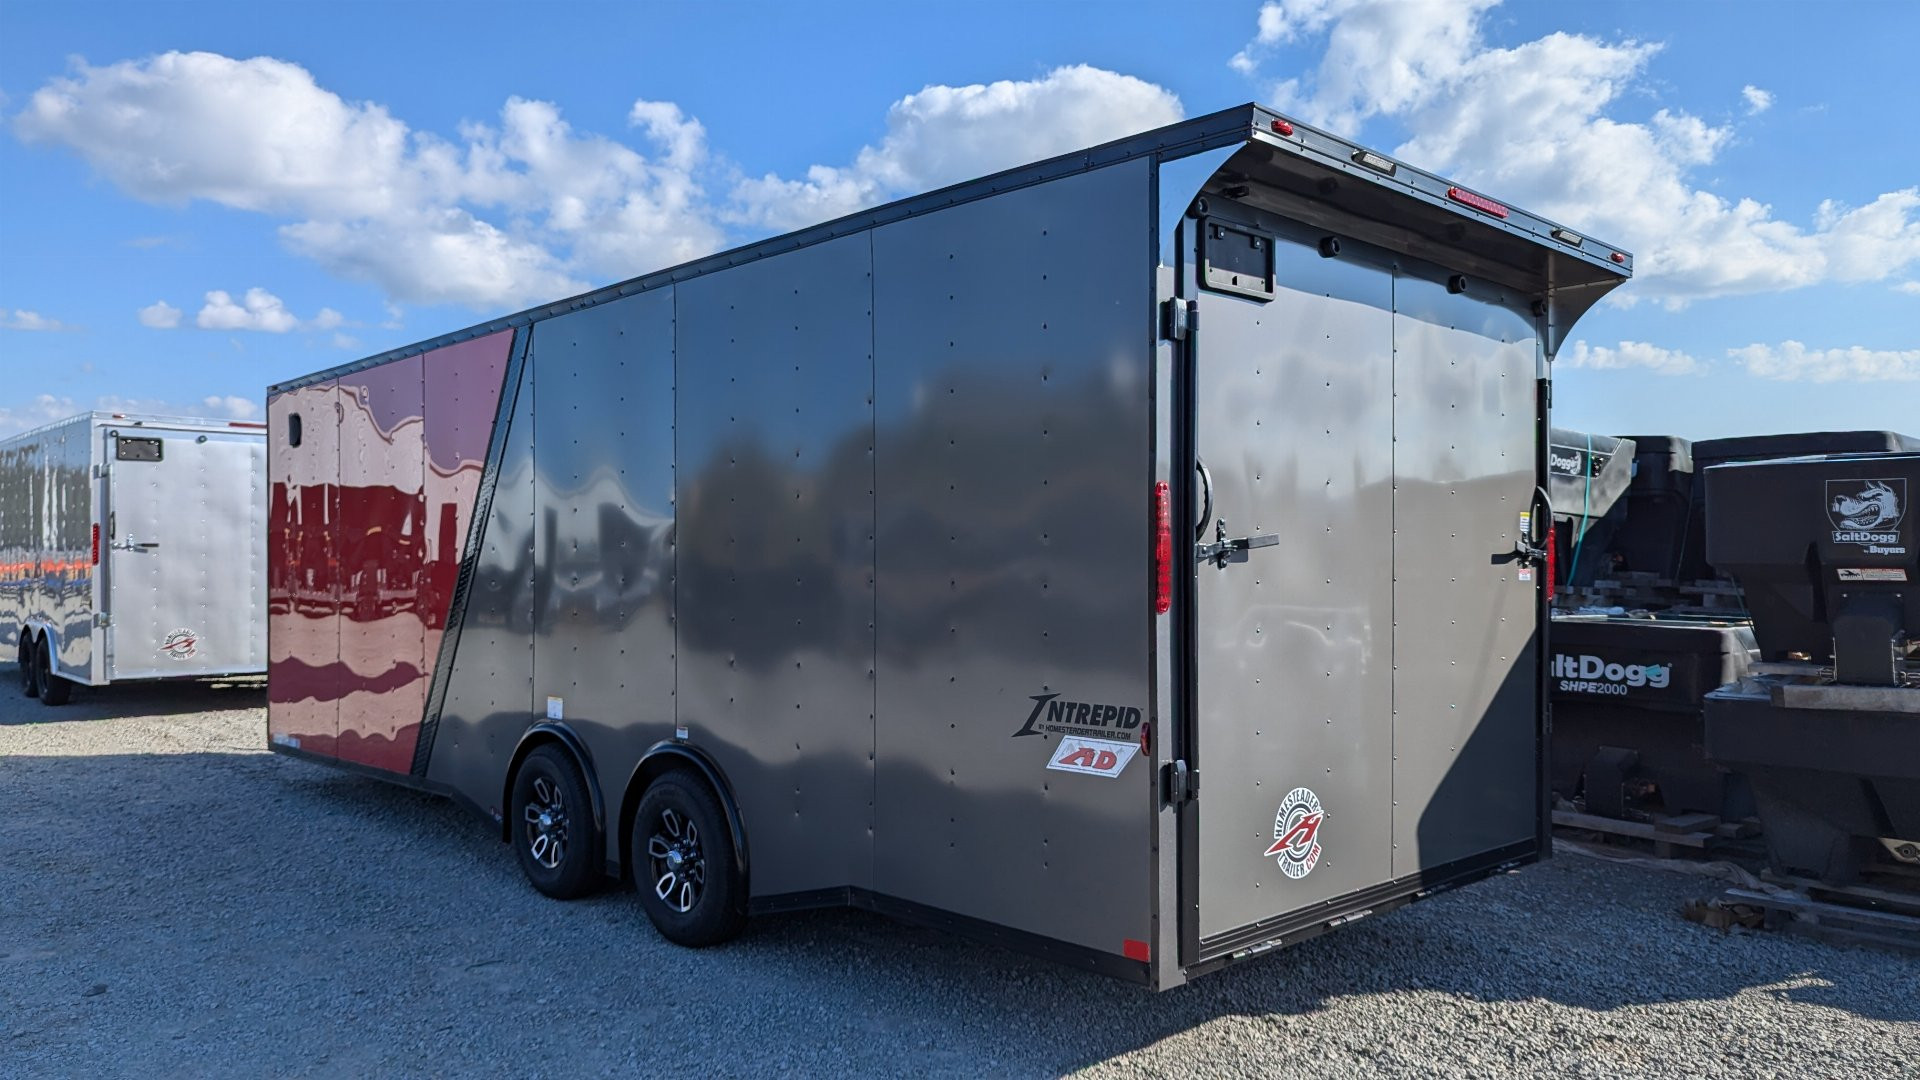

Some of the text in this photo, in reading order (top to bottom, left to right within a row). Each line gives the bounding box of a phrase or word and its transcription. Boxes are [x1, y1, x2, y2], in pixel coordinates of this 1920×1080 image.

[1835, 532, 1897, 543] SaltDogg
[1869, 545, 1906, 555] Buyers
[1550, 653, 1670, 688] ltDogg
[1560, 680, 1628, 695] SHPE2000
[1011, 693, 1142, 737] INTREPID
[1045, 724, 1131, 740] HOMESTEADERTRAILER.COM
[1275, 788, 1320, 838] HOMESTEADER
